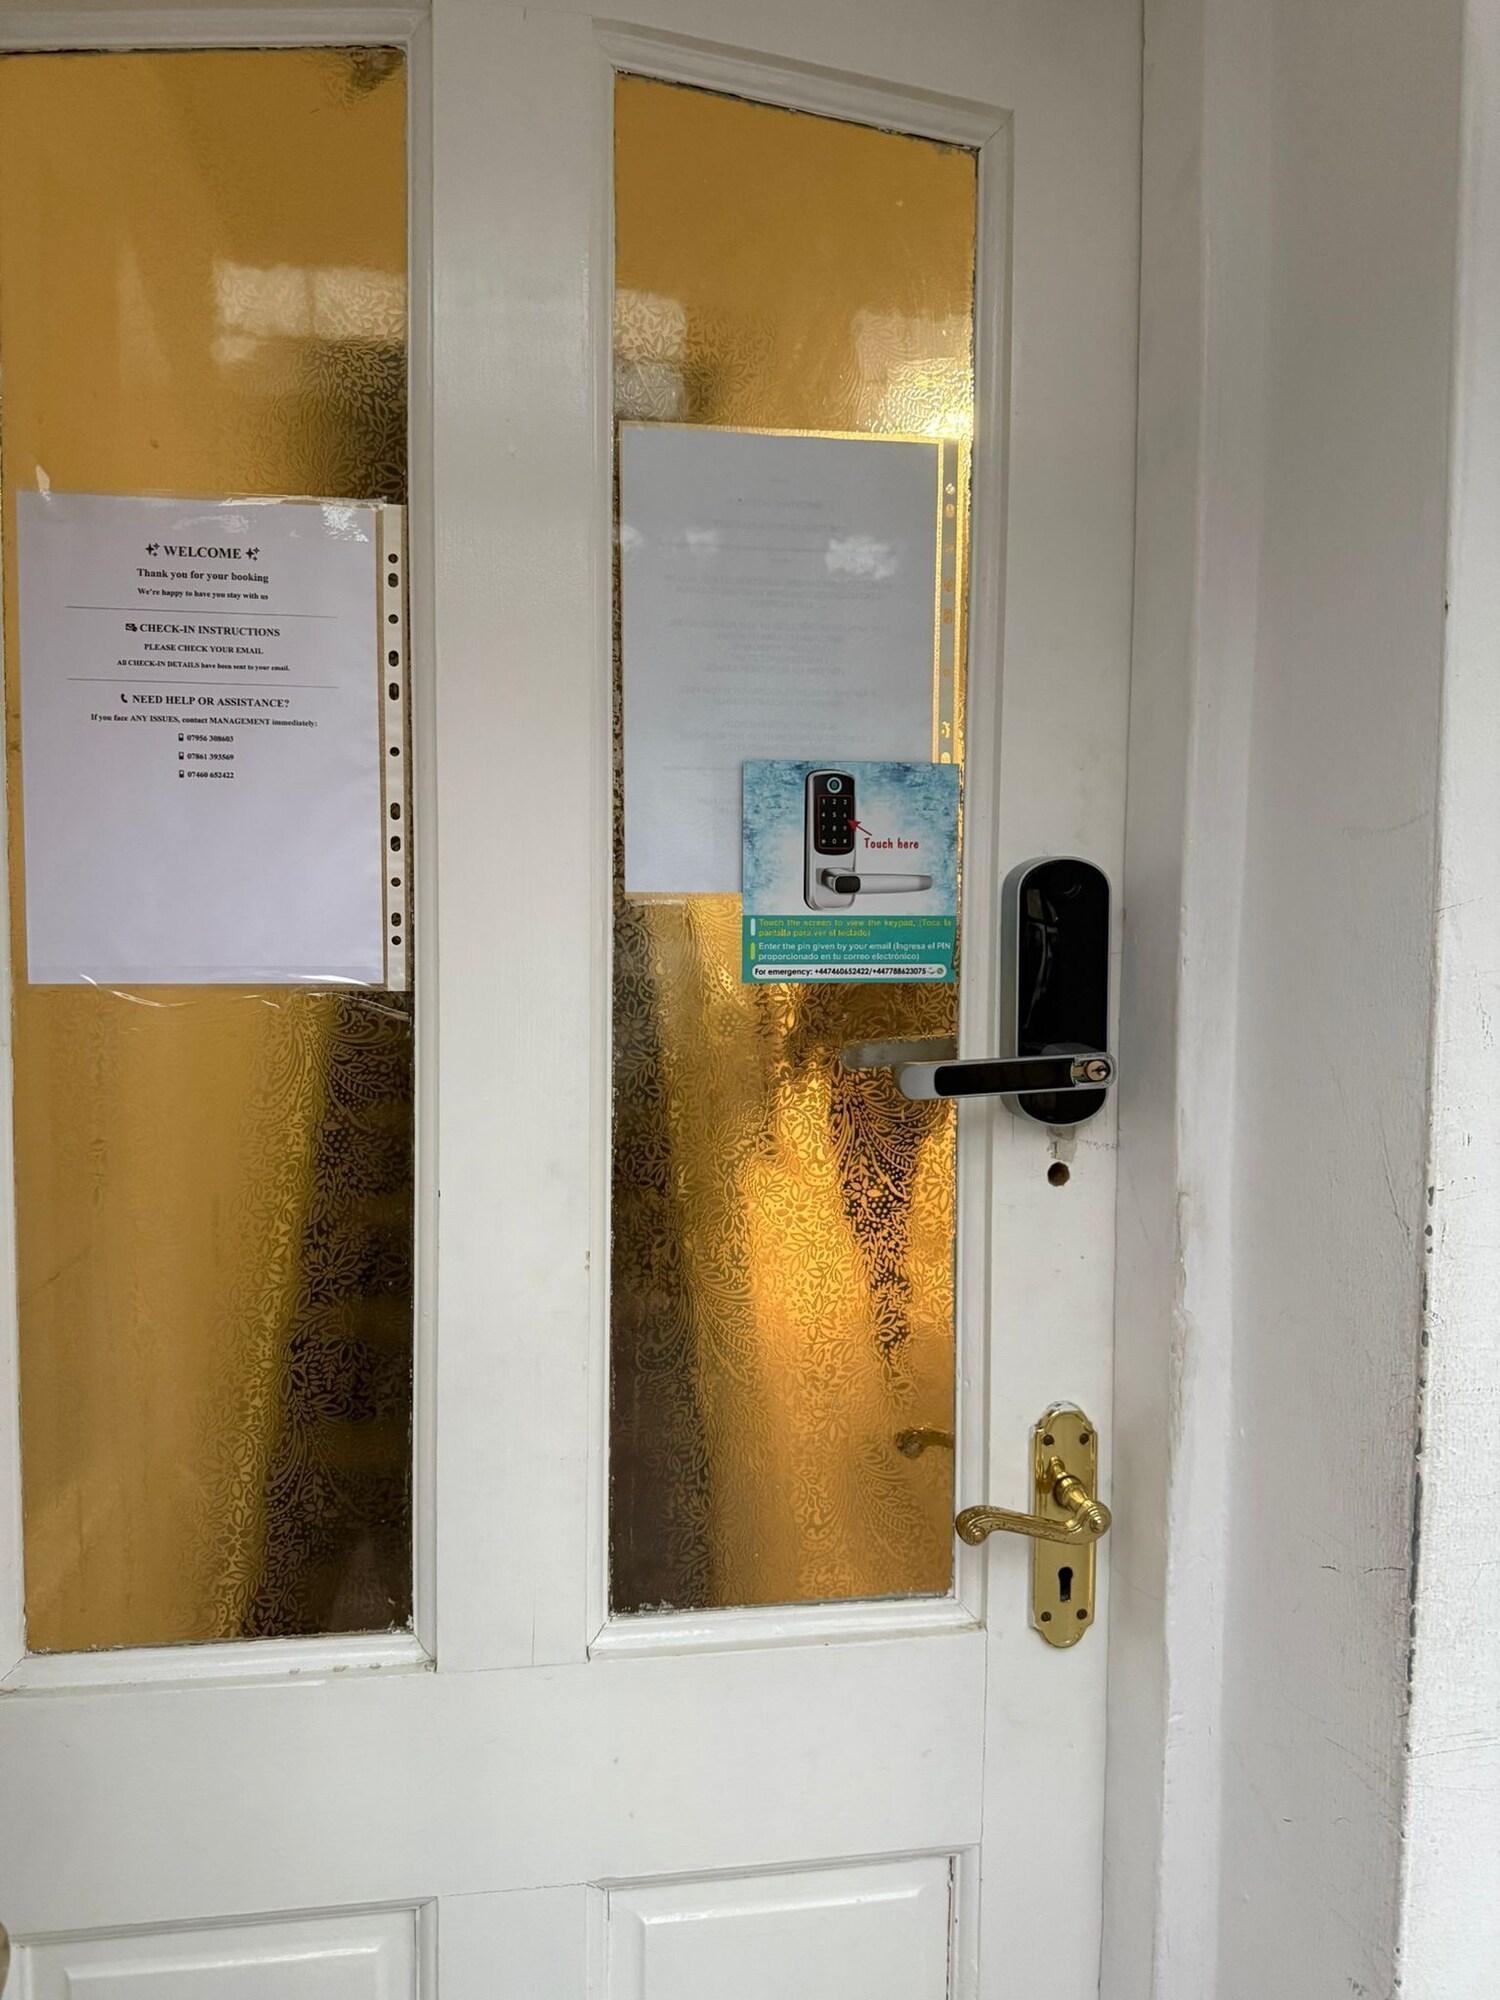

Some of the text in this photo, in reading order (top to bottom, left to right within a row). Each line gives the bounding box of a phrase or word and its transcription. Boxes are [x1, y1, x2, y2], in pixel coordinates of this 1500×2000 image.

[163, 545, 242, 560] WELCOME
[136, 568, 269, 584] Thank you for your booking
[137, 587, 161, 596] We're
[161, 589, 184, 598] happy
[194, 590, 211, 598] have
[227, 592, 241, 600] stay
[243, 592, 259, 600] with
[139, 623, 280, 637] CHECK-IN INSTRUCTIONS
[144, 643, 264, 655] PLEASE CHECK YOUR EMAIL
[132, 694, 290, 708] NEED HELP OR ASSISTANCE?
[90, 713, 98, 721] If
[98, 714, 112, 723] you
[113, 714, 128, 722] face
[150, 715, 181, 724] ISSUES,
[182, 717, 208, 725] contact
[209, 717, 270, 726] MANAGEMENT
[272, 718, 318, 728] immediately:
[186, 734, 208, 742] 07956
[864, 837, 919, 849] Touch here
[758, 918, 784, 927] Touch
[787, 919, 801, 927] the
[834, 919, 842, 927] to
[847, 919, 864, 927] view
[868, 919, 881, 927] the
[758, 928, 792, 938] pantalla
[793, 930, 812, 938] para
[830, 929, 837, 937] el
[758, 942, 951, 952] Enter the pin given by your email (Ingresa el PIN
[758, 953, 819, 962] proporcionado
[871, 952, 920, 962] electrónico)
[755, 968, 766, 976] For
[768, 968, 813, 977] emergency:
